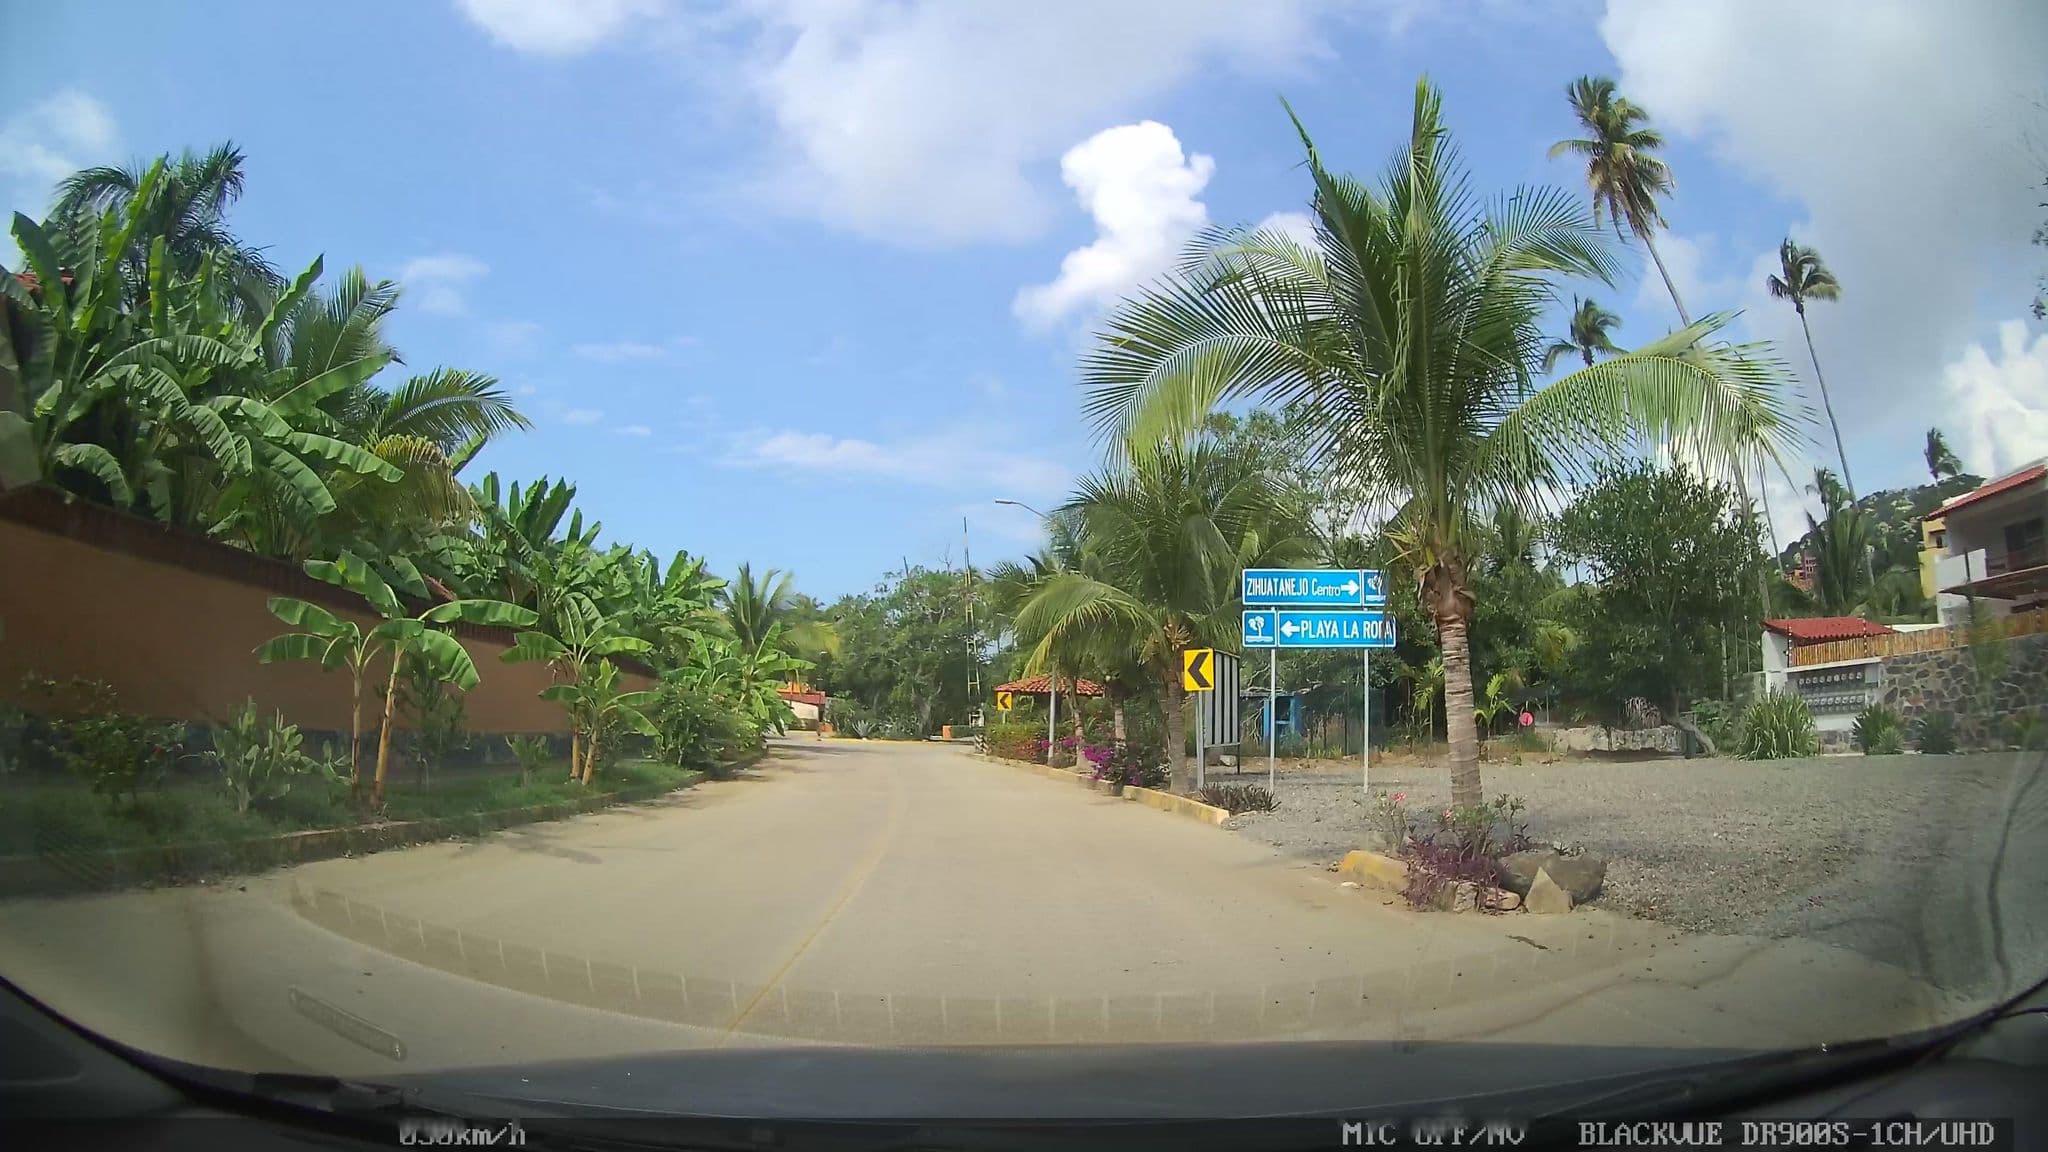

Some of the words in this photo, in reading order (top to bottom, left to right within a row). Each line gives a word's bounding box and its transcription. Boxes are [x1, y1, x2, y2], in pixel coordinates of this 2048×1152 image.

[1247, 578, 1308, 596] ZIHUATANEJO
[1311, 578, 1341, 597] Centro
[1301, 620, 1339, 639] PLAYA
[1343, 620, 1360, 639] LA
